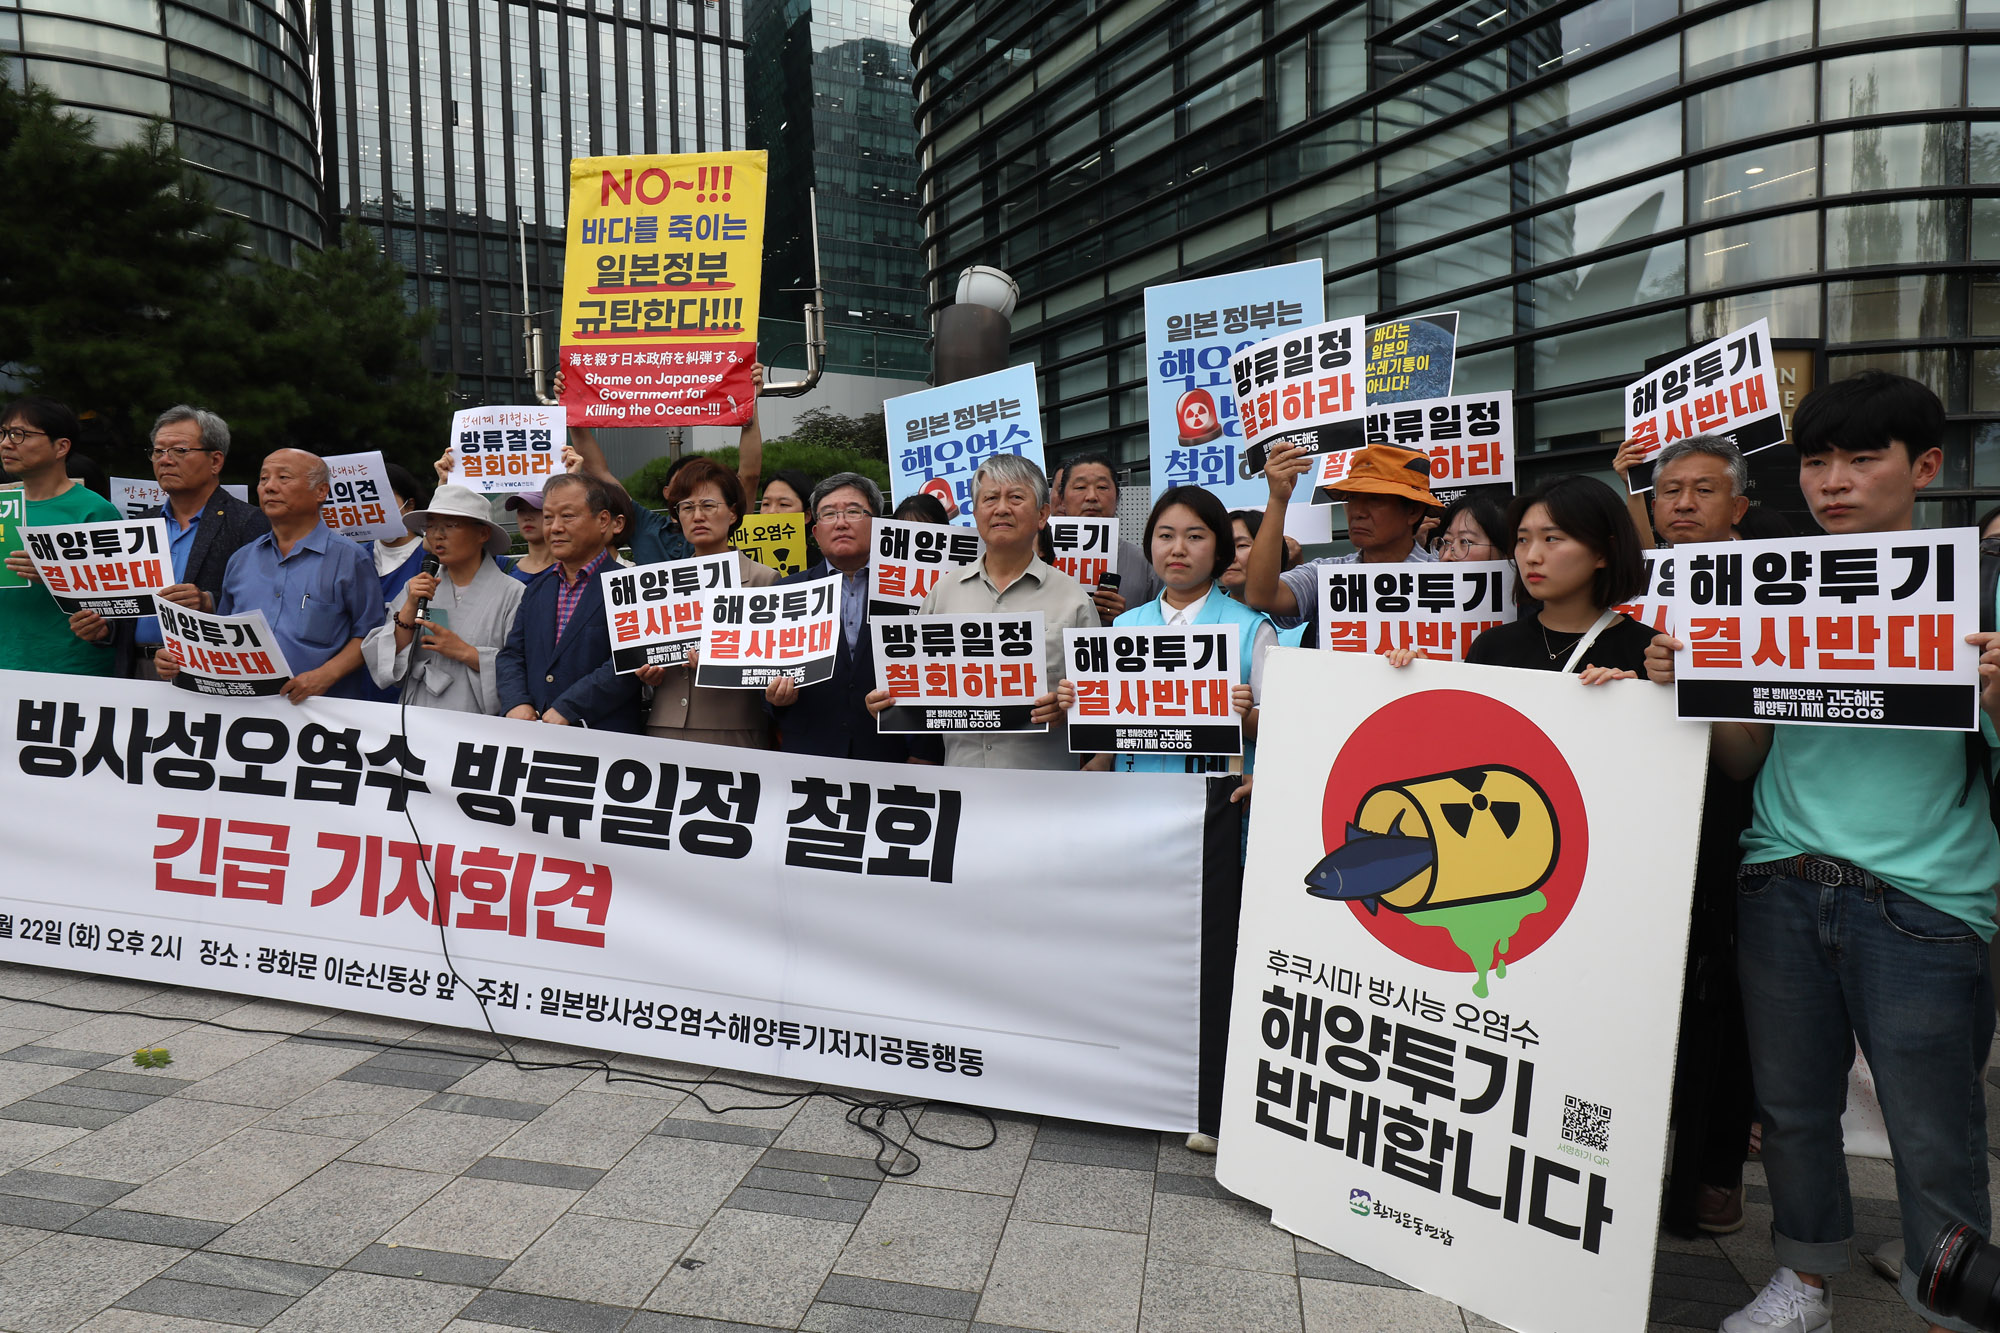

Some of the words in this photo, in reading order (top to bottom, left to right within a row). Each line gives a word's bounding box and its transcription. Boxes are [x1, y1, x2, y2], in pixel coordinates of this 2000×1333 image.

[600, 165, 733, 207] NO~!!!
[581, 215, 659, 245] 바다를
[668, 213, 748, 242] 죽이는
[596, 251, 728, 288] 일본정부
[575, 297, 743, 335] 규탄한다!!!
[1166, 310, 1219, 343] 일본
[1222, 299, 1303, 335] 정부는
[1373, 322, 1410, 343] 바다는
[569, 350, 744, 367] 海を殺す日本政府を糾弾する。
[1157, 338, 1256, 392] 핵오
[1233, 327, 1352, 398] 방류일정
[1364, 354, 1430, 378] 쓰레기통이
[1371, 339, 1409, 361] 일본의
[584, 373, 634, 386] Shame
[635, 374, 652, 386] on
[655, 372, 724, 386] Japanese
[599, 388, 684, 401] Government
[686, 387, 707, 400] for
[1366, 375, 1410, 394] 아니다!
[1632, 331, 1762, 419] 해양투기
[461, 414, 494, 428] 전세계
[498, 411, 550, 427] 위협하는
[585, 404, 628, 418] Killing
[629, 403, 651, 416] the
[653, 402, 721, 417] Ocean~!!!
[905, 412, 950, 443] 일본
[953, 398, 1021, 431] 정부는
[1240, 373, 1355, 440] 철회하라
[1366, 400, 1500, 444] 방류일정
[1631, 373, 1768, 455] 결사반대
[460, 429, 552, 454] 방류결정
[899, 423, 1033, 483] 핵오염수
[461, 453, 554, 478] 철회하라
[322, 503, 386, 529] 렴하라
[752, 523, 797, 542] 오염수
[27, 525, 159, 561] 해양투기
[879, 525, 980, 566] 해양투
[1053, 523, 1110, 553] 투기
[41, 559, 164, 593] 결사반대
[609, 560, 732, 607] 해양투기
[877, 563, 940, 599] 결사
[1329, 570, 1503, 614] 해양투기
[1689, 543, 1955, 606] 해양투기
[614, 600, 703, 643] 결사반
[712, 583, 834, 625] 해양투기
[158, 603, 262, 648] 해양투기
[710, 619, 833, 660] 결사반대
[881, 620, 1033, 658] 방류일정
[1689, 613, 1955, 671] 결사반대
[165, 635, 277, 676] 결사반대
[1073, 634, 1228, 674] 해양투기
[885, 662, 1037, 699] 철회하라
[1076, 679, 1229, 718] 결사반대
[1752, 687, 1770, 700] 일본
[1771, 687, 1824, 701] 방사성오염수
[926, 718, 953, 729] 해양투기
[1753, 700, 1798, 717] 해양투기
[1800, 702, 1824, 718] 저지
[1116, 738, 1144, 750] 해양투기
[16, 698, 431, 813] 방사성오염수
[450, 741, 761, 860] 방류일정
[784, 776, 962, 884] 철회
[152, 813, 291, 905] 긴급
[310, 831, 613, 948] 기자회견
[20, 918, 62, 946] 22일
[68, 922, 101, 952] (화)
[106, 927, 145, 957] 오후
[150, 934, 183, 961] 2시
[199, 939, 239, 969] 장소
[256, 947, 318, 980] 광화문
[324, 955, 431, 996] 이순신동상
[435, 972, 459, 1001] 앞
[475, 977, 520, 1011] 주최
[539, 986, 985, 1078] 일본방사성오염수해양투기저지공동행동
[1266, 949, 1362, 1000] 후쿠시마
[1368, 976, 1447, 1023] 방사능
[1452, 1002, 1540, 1050] 오염수
[1261, 984, 1535, 1138] 해양투기
[1254, 1058, 1613, 1255] 반대합니다
[1556, 1143, 1592, 1162] 서명하기
[1593, 1155, 1610, 1168] QR
[1372, 1200, 1455, 1247] 환경운동연합
